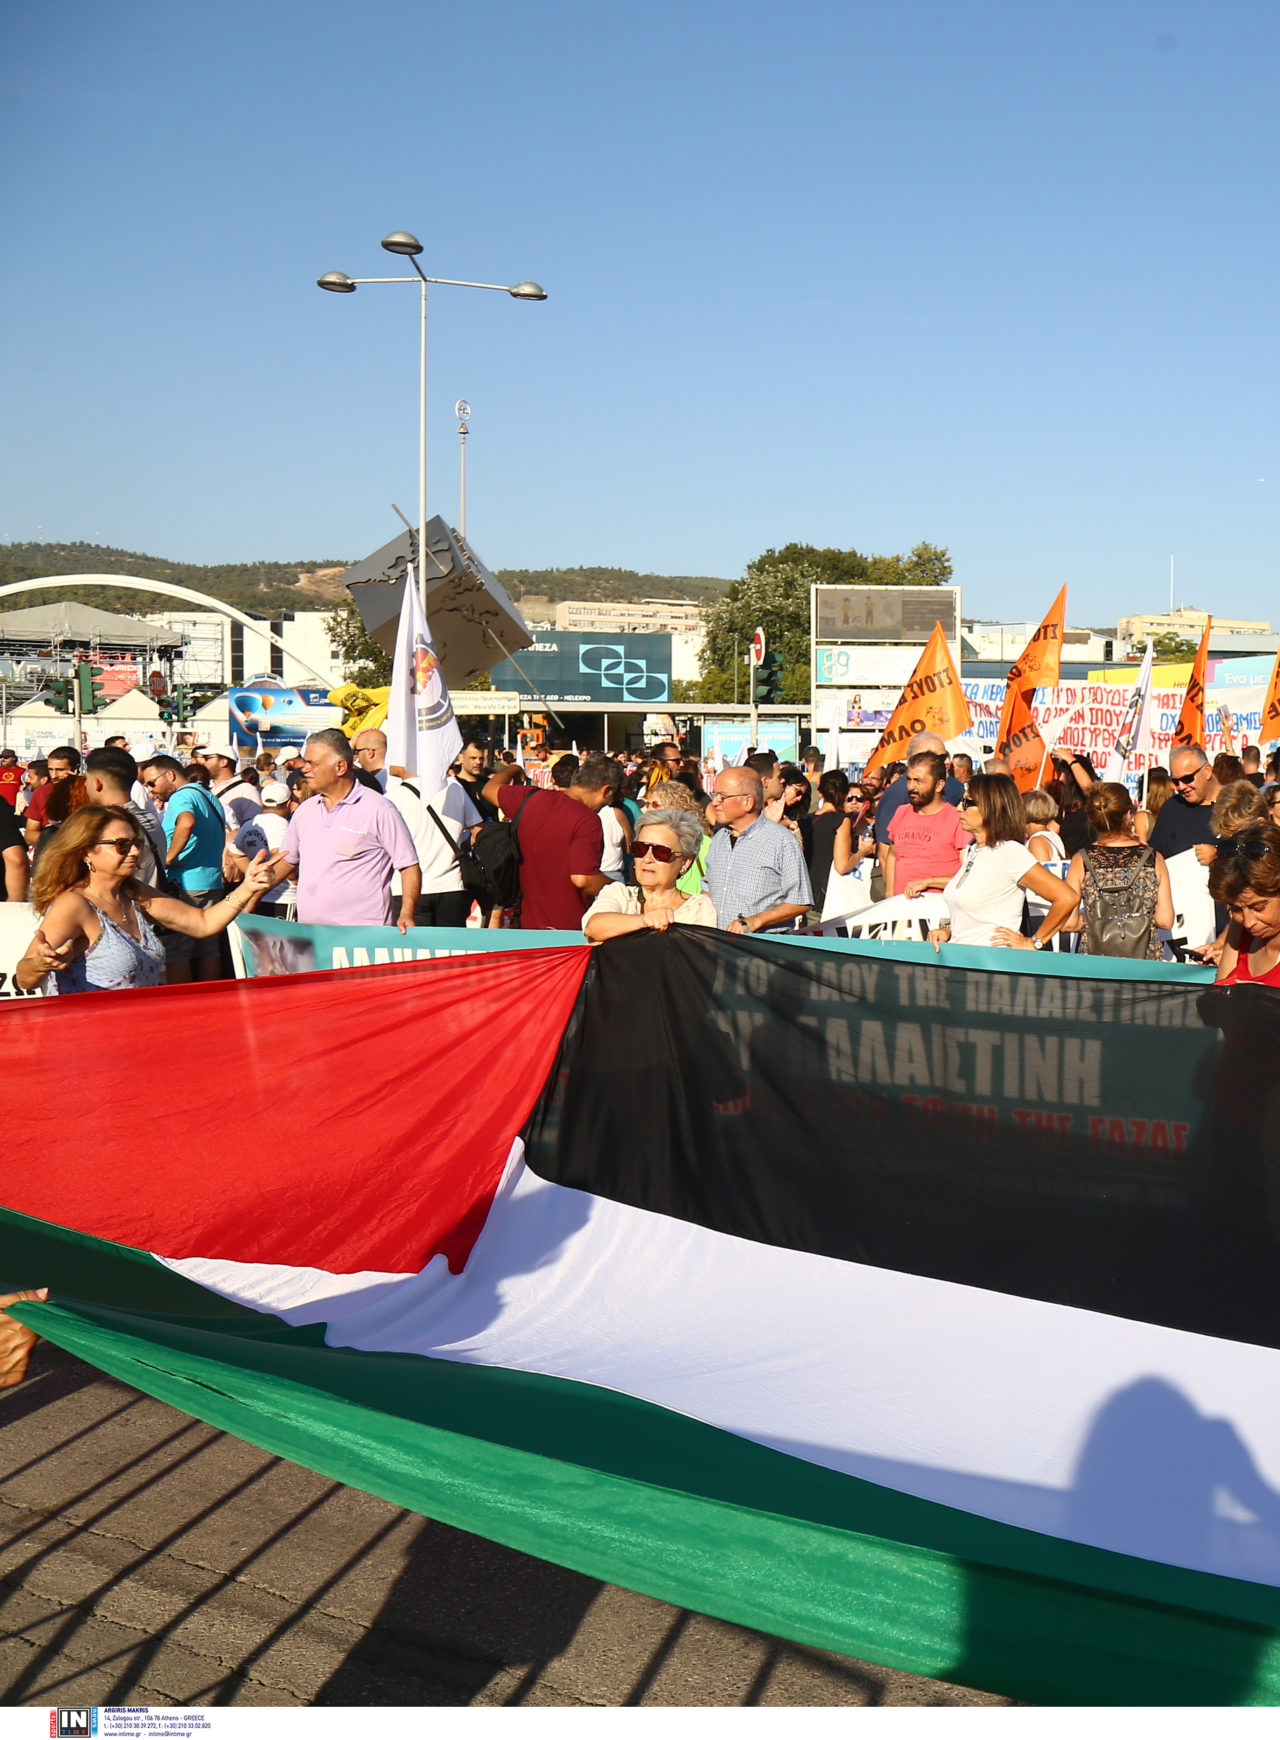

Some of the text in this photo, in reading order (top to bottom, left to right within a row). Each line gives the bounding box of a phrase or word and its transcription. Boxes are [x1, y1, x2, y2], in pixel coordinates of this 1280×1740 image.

[151, 677, 166, 691] STOP
[1081, 686, 1129, 707] ΣΠΟΥΔΕ
[1089, 707, 1125, 727] ΣΠΟΥ
[898, 831, 932, 843] GRAND
[796, 1015, 1102, 1107] ΑΛΑΙΣΤΙΝΗ
